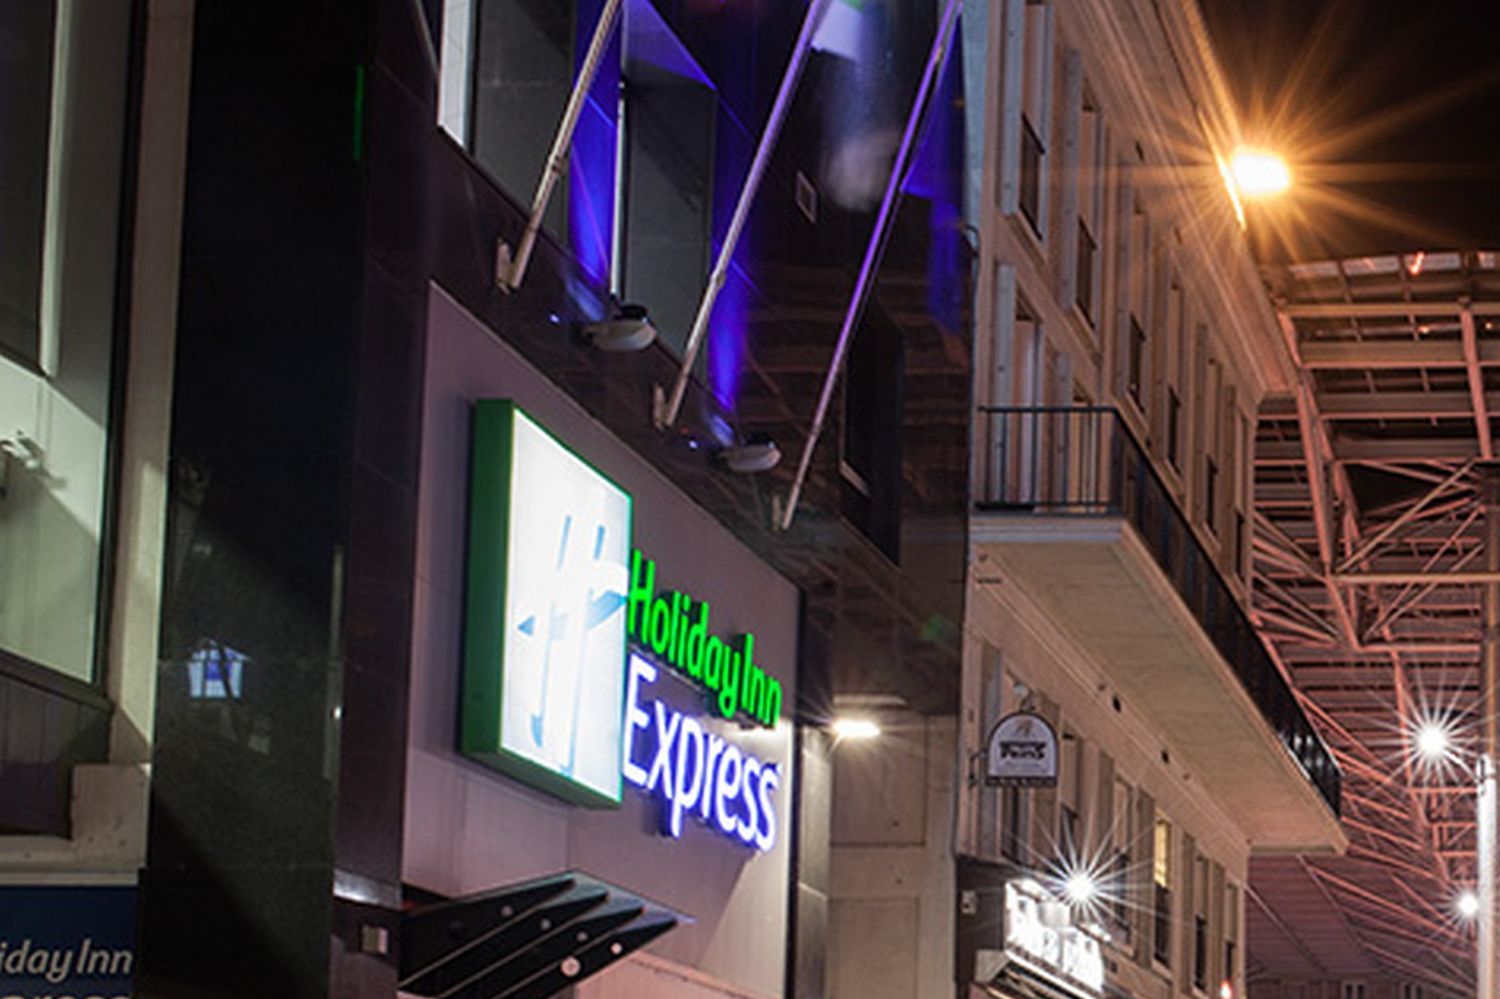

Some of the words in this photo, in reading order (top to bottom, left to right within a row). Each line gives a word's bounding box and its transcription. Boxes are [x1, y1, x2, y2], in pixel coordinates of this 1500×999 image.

[627, 549, 741, 718] Holiday
[741, 631, 783, 728] Inn
[623, 653, 781, 850] Express
[76, 938, 133, 974] Inn
